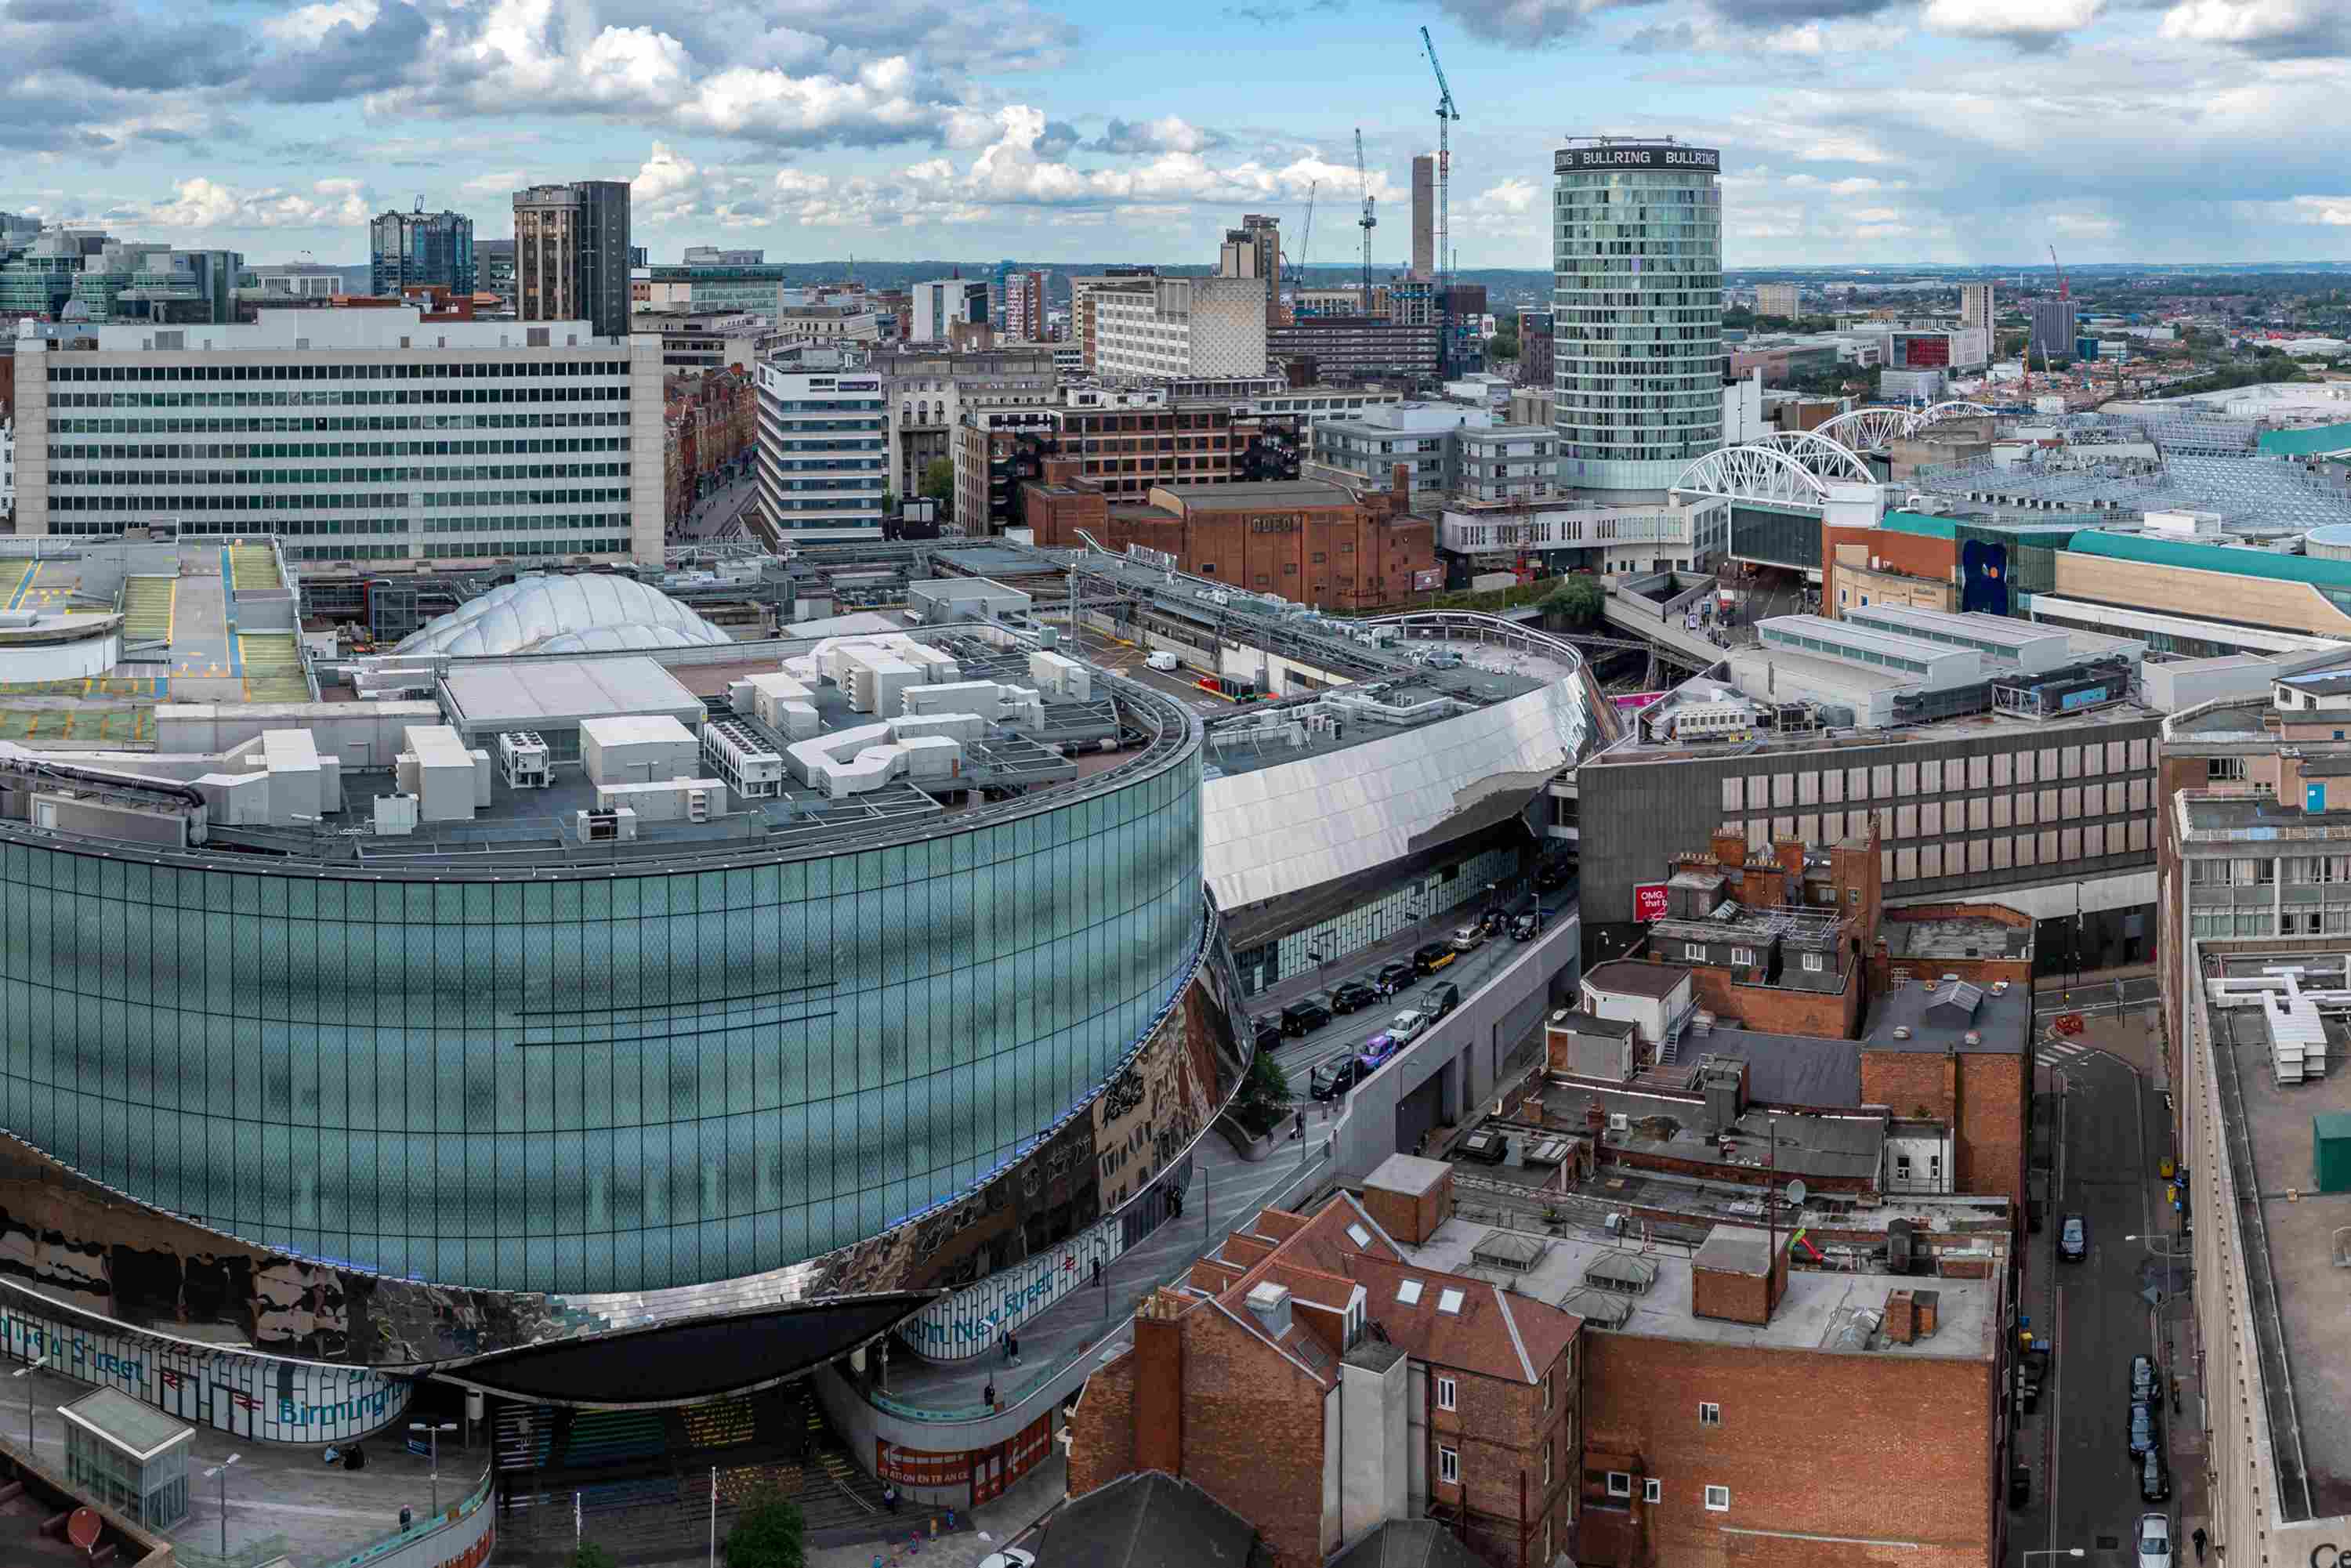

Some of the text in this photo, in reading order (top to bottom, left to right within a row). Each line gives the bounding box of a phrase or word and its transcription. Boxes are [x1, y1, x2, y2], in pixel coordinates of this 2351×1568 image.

[1582, 151, 1651, 165] BULLRING
[1665, 151, 1716, 165] BULLRING
[1003, 1270, 1053, 1317] Street
[74, 1336, 143, 1382] Street
